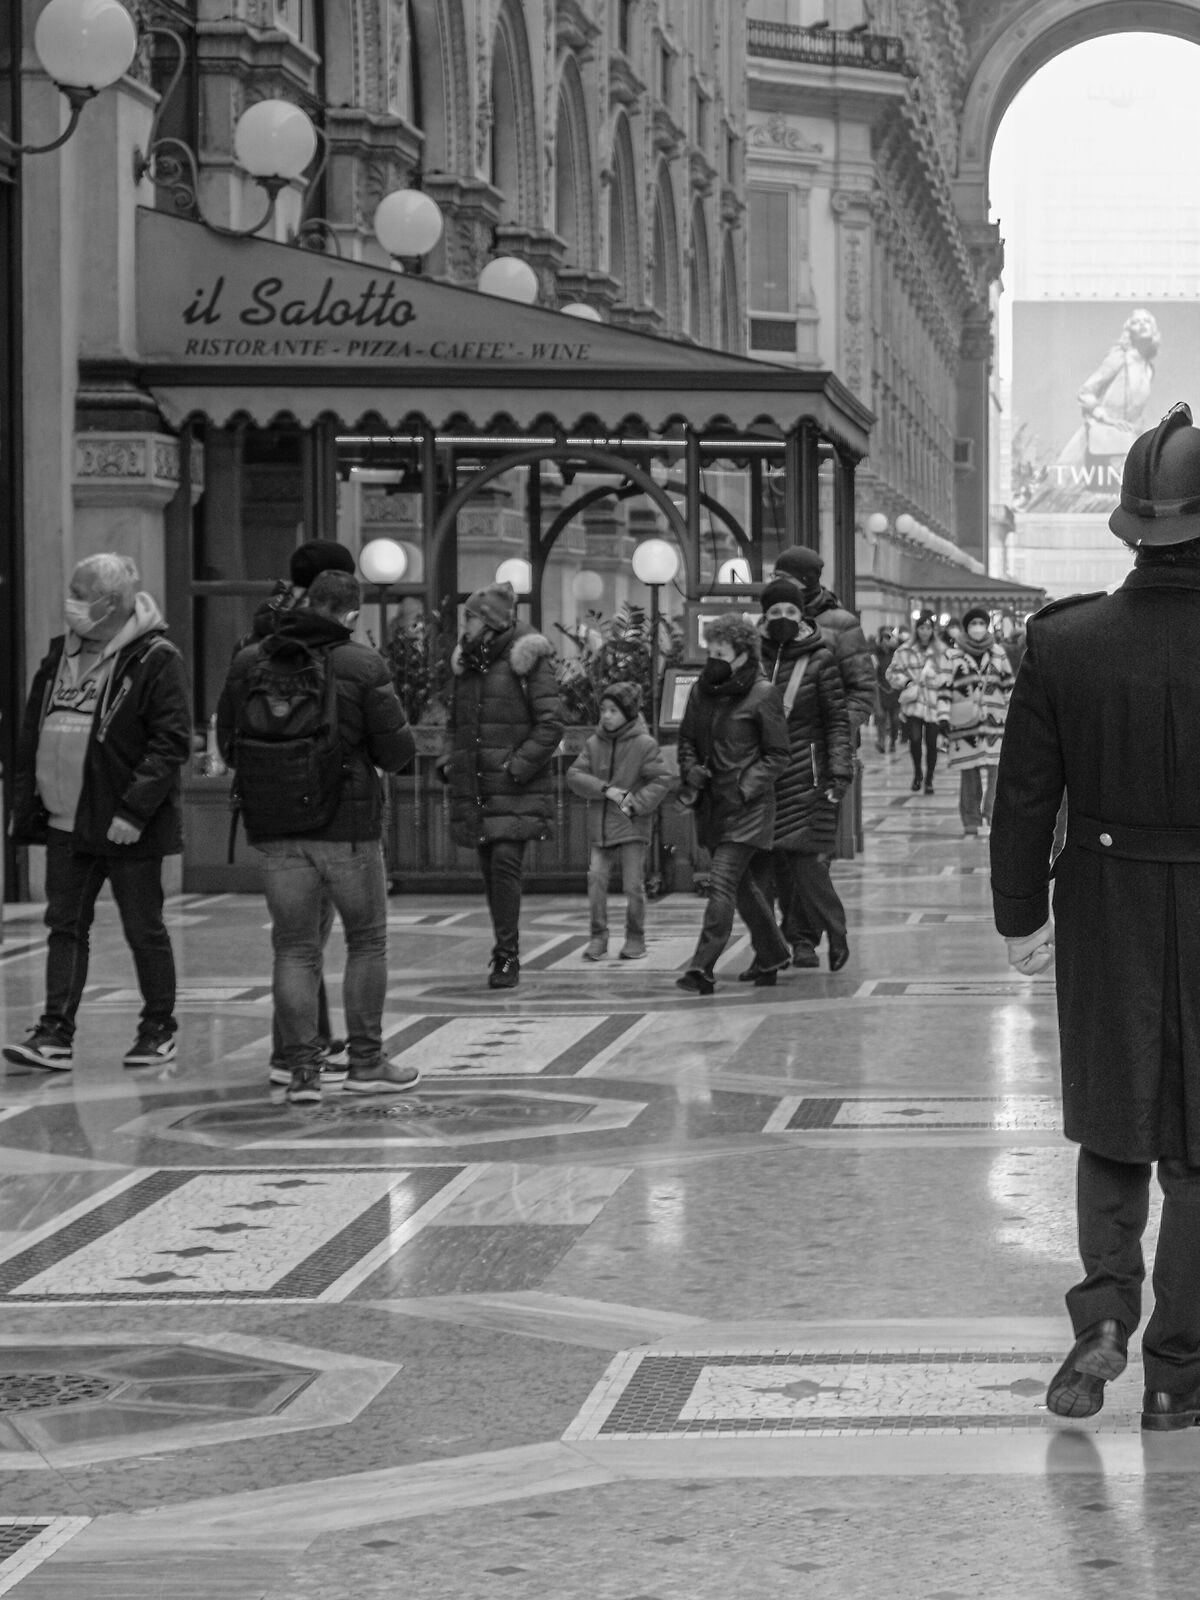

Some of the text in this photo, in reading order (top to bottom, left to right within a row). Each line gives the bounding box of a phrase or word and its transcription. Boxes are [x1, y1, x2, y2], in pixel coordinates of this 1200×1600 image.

[182, 275, 417, 327] il Salotto
[185, 338, 328, 356] RISTORANTE
[347, 339, 412, 358] PIZZA
[531, 342, 592, 361] WINE
